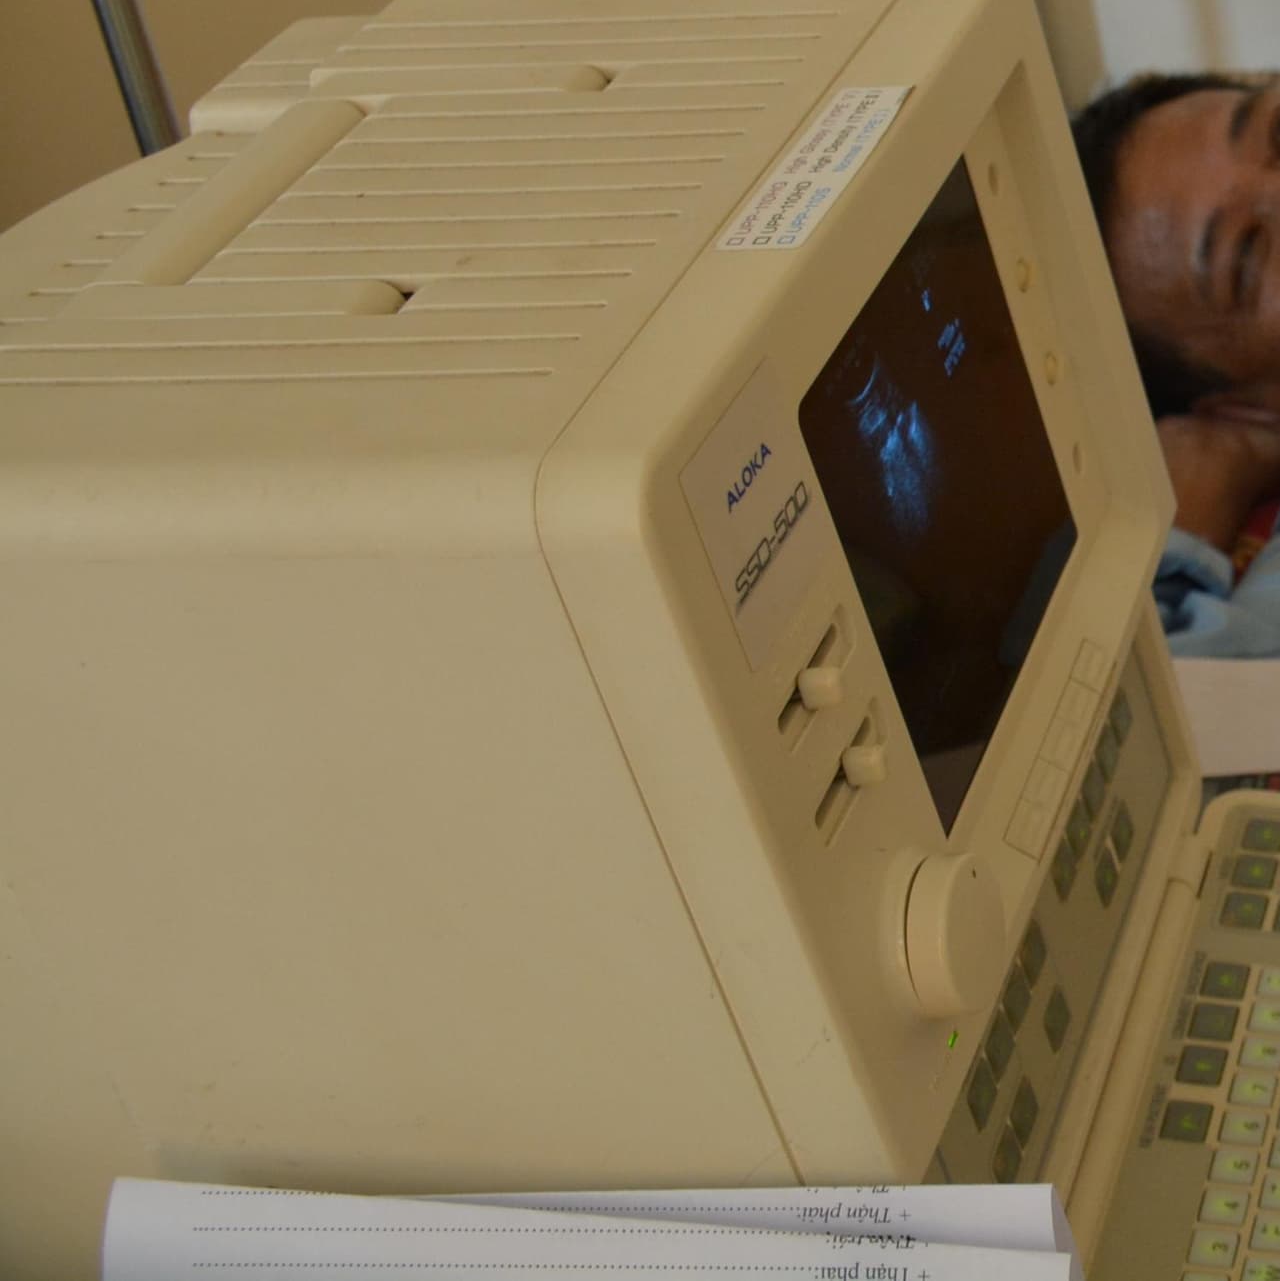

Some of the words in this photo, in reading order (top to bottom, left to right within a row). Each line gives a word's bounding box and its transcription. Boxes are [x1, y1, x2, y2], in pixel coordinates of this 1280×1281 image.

[760, 181, 812, 235] UPP-110HD
[808, 156, 832, 174] High
[823, 125, 858, 154] Density
[727, 442, 772, 514] ALOKA
[735, 480, 809, 606] SSD-500
[846, 1203, 891, 1223] Thận
